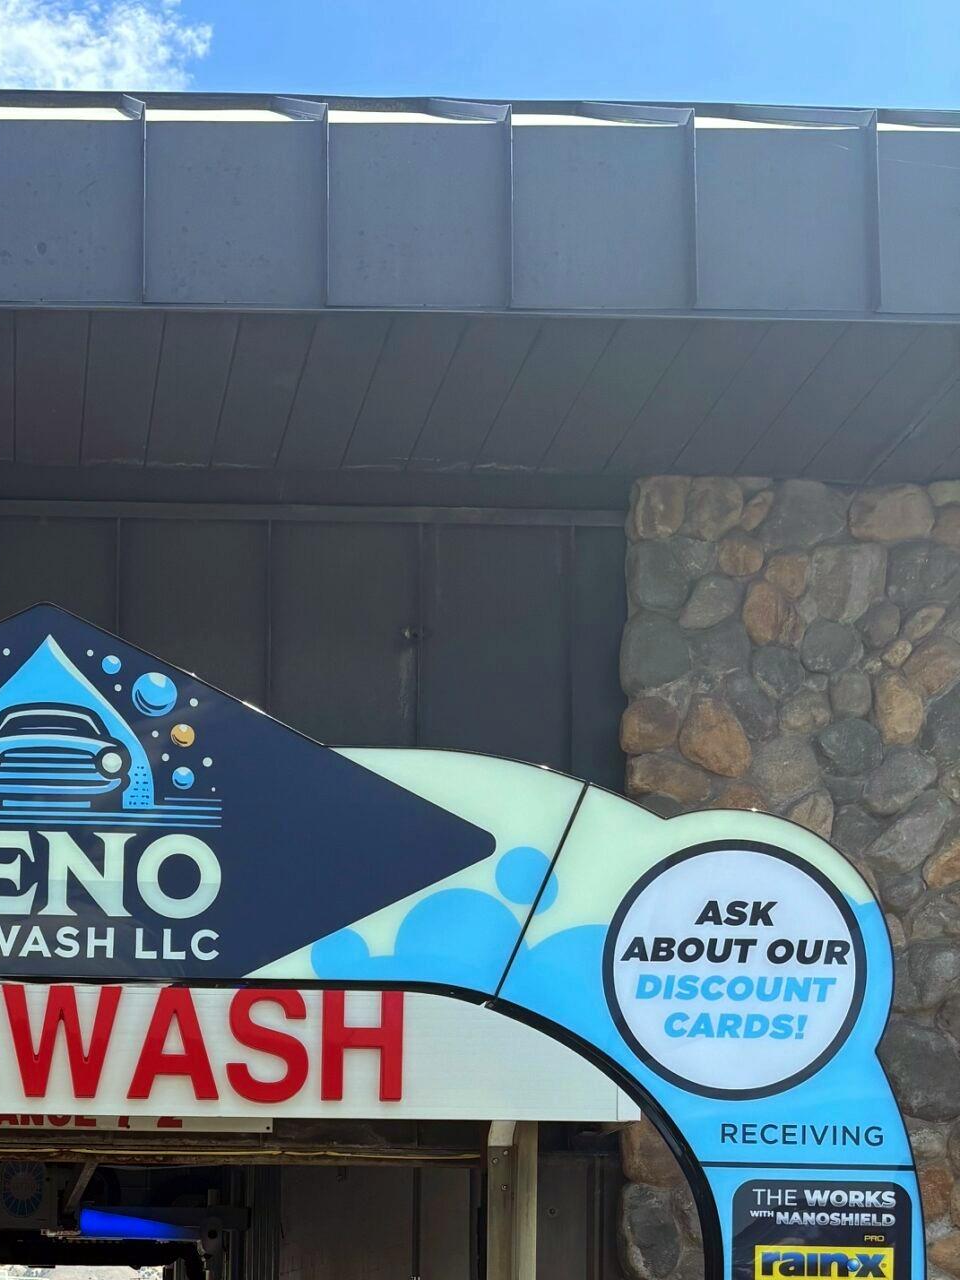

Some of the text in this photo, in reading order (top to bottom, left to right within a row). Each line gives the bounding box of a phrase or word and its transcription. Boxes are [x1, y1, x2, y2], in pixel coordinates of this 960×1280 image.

[694, 900, 778, 927] ASK
[133, 928, 221, 963] LLC
[620, 936, 851, 965] ABOUT OUR
[635, 973, 837, 1003] DISCOUNT
[664, 1011, 808, 1040] CARDS!
[720, 1122, 884, 1147] RECEIVING
[752, 1188, 897, 1208] THE WORKS
[750, 1210, 897, 1227] WITH NANOSHIELD
